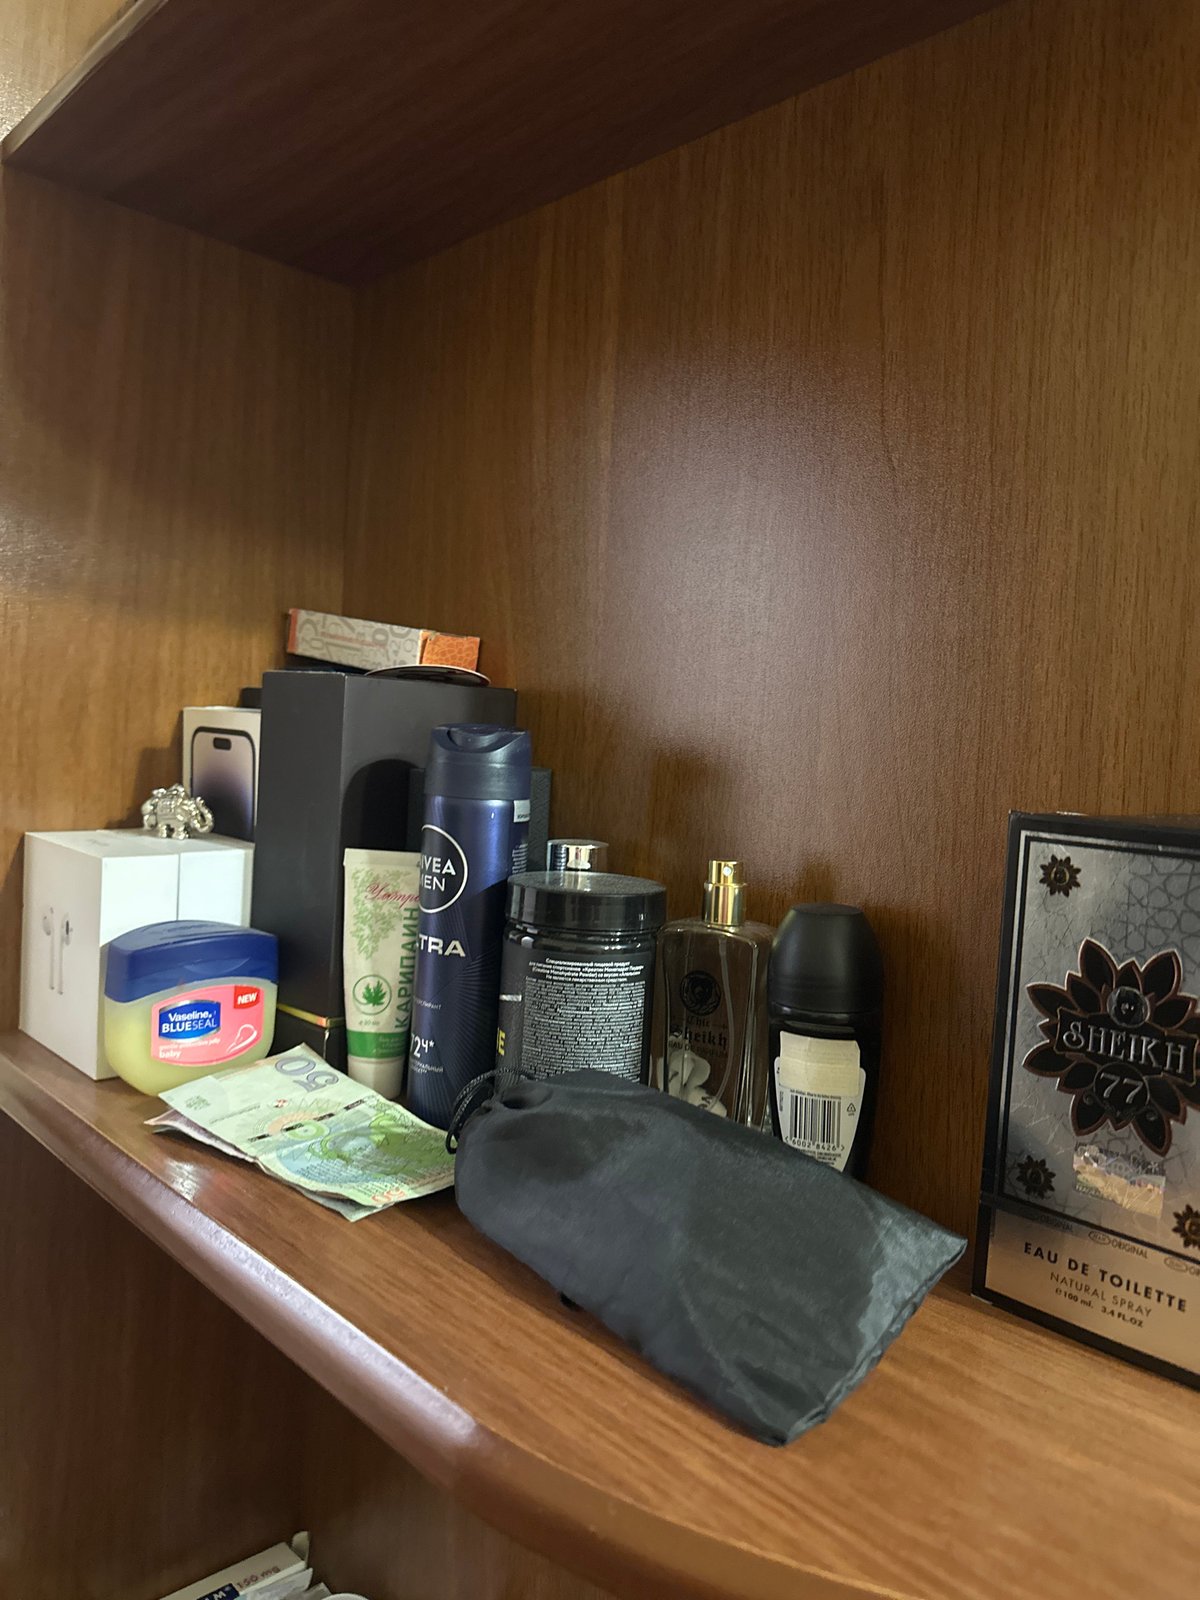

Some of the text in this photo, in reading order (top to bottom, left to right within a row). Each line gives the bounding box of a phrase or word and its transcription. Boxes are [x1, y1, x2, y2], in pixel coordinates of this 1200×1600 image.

[421, 854, 456, 876] IVEA
[421, 873, 446, 892] EN
[416, 933, 466, 958] TRA
[237, 992, 258, 1005] NEW
[159, 1050, 181, 1059] baby
[1062, 1020, 1187, 1075] SHEIKH
[274, 1056, 339, 1092] 50
[1100, 1072, 1144, 1104] 77
[1111, 1237, 1148, 1259] ORIGINAL
[1023, 1241, 1058, 1264] EAU
[1067, 1257, 1089, 1277] DE
[1099, 1268, 1187, 1313] TOILETTE
[1050, 1271, 1153, 1318] NATURAL SPRAY
[1101, 1305, 1115, 1318] 3.4
